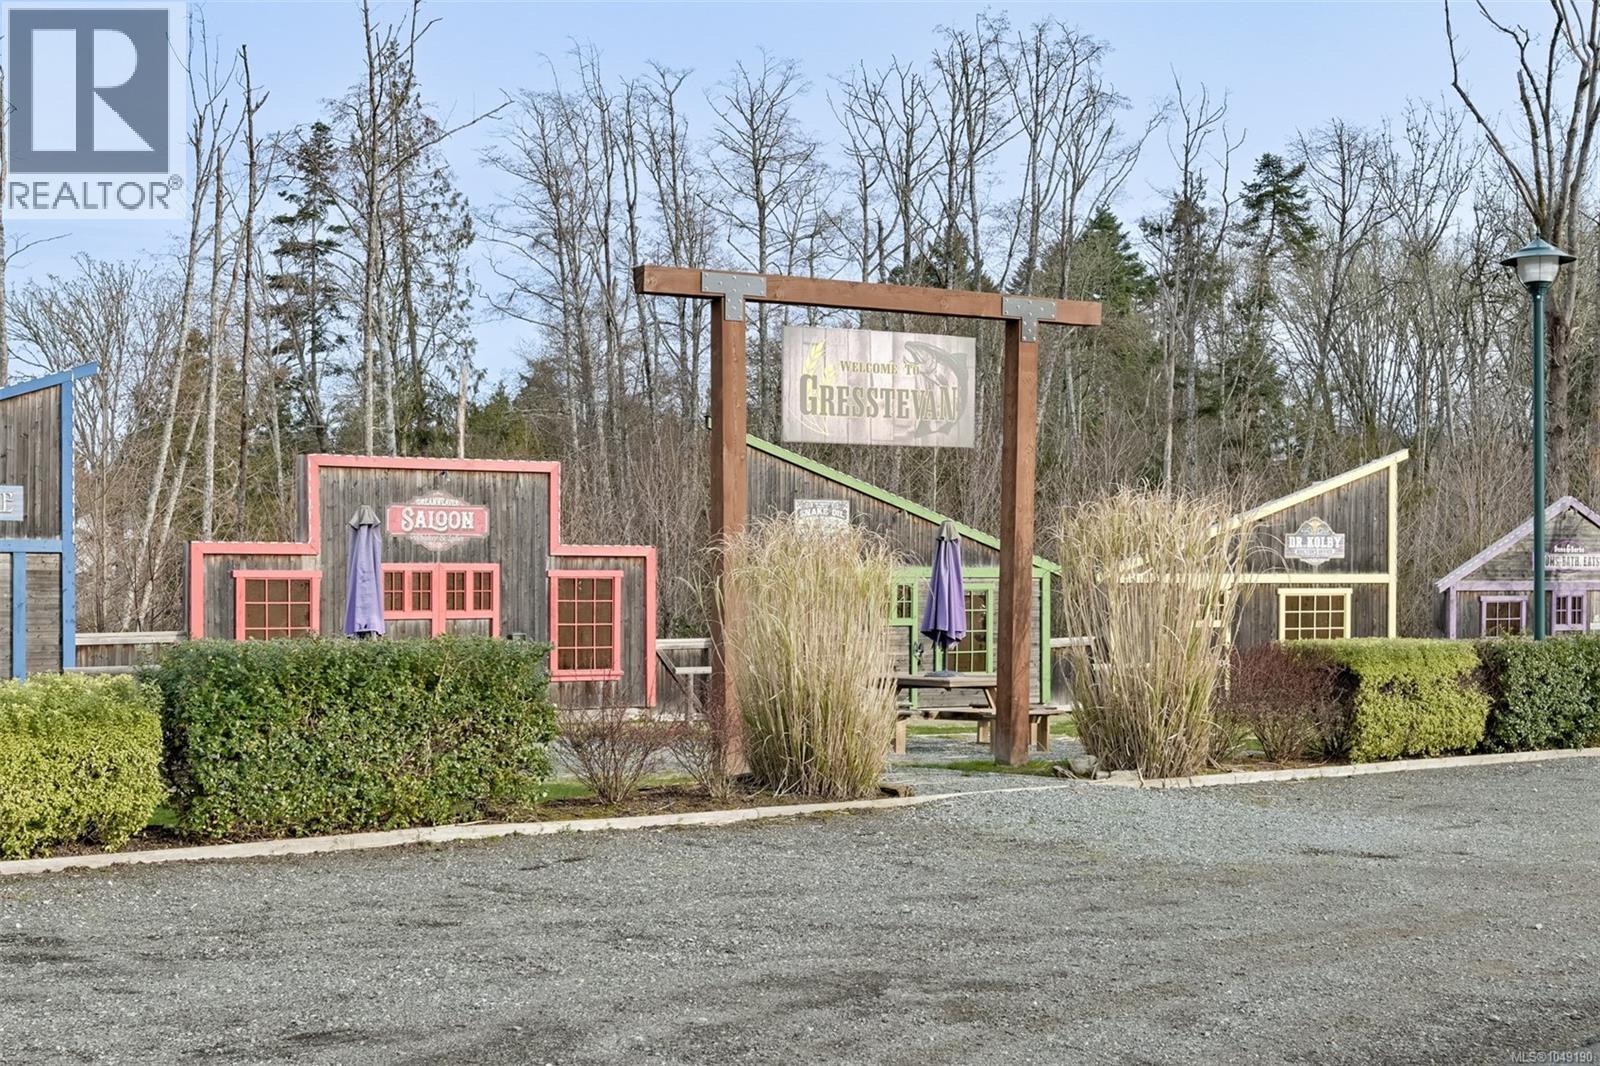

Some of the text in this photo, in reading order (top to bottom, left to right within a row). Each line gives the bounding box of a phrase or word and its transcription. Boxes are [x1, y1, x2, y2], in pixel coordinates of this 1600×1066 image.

[840, 360, 898, 375] WELCOME
[799, 373, 958, 421] GRESSTEVAN
[401, 506, 475, 532] SALOON
